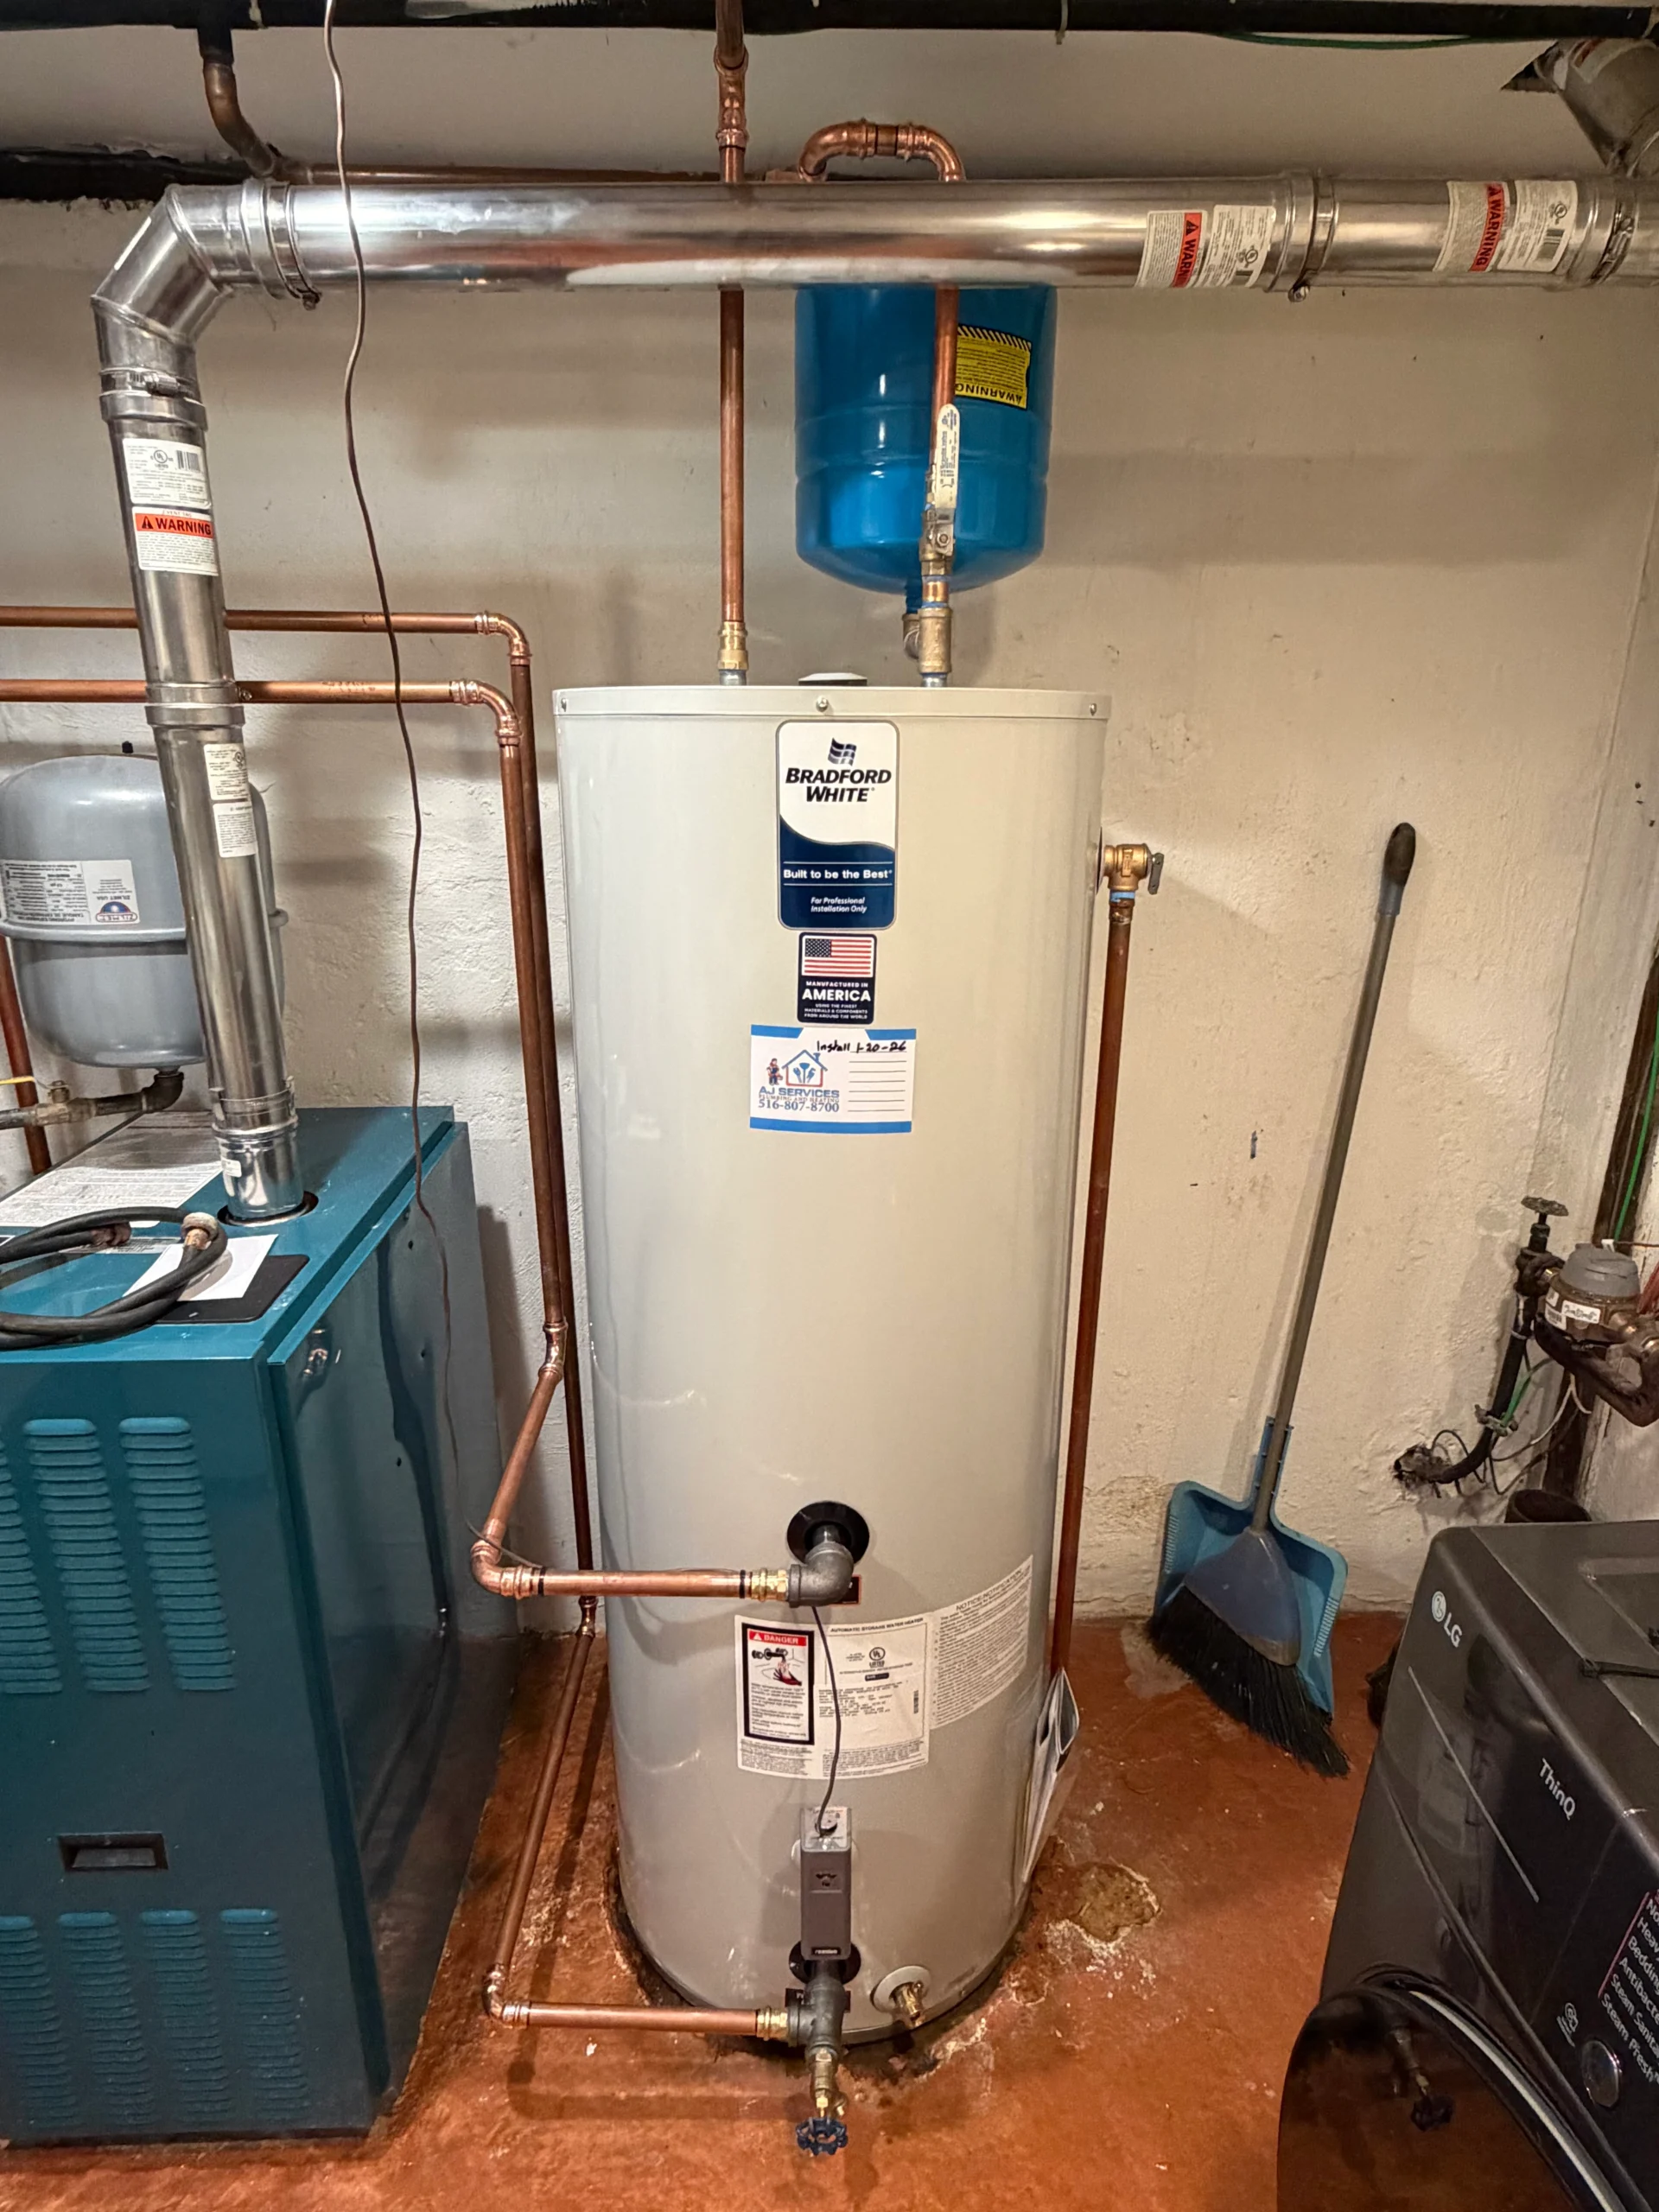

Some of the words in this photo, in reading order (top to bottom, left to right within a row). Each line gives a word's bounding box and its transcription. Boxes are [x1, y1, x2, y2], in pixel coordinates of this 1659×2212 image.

[1476, 200, 1502, 266] WARNING
[1176, 238, 1197, 283] WARN
[955, 383, 1016, 404] WARNING
[155, 517, 212, 536] WARNING
[785, 767, 892, 784] BRADFORD
[806, 785, 868, 803] WHITE
[783, 869, 808, 879] Built
[810, 870, 821, 879] to
[824, 870, 839, 880] be
[842, 870, 860, 880] the
[863, 869, 888, 880] Best
[850, 905, 867, 914] Only
[802, 988, 871, 1001] AMERICA
[817, 1039, 850, 1052] Install
[759, 1085, 775, 1095] AJ
[778, 1087, 840, 1098] SERVICES
[758, 1098, 840, 1113] 516-807-8700
[904, 1617, 924, 1626] HEATER
[1443, 1611, 1463, 1649] LG
[763, 1634, 799, 1645] DANGER
[1539, 1757, 1576, 1821] ThinQ
[1646, 1898, 1659, 1924] No
[1637, 1916, 1659, 1961] Heav
[1628, 1936, 1659, 1996] Bedding
[1601, 1993, 1629, 2041] Steam
[1611, 1973, 1635, 2016] Steam
[1634, 2011, 1659, 2062] Sanita
